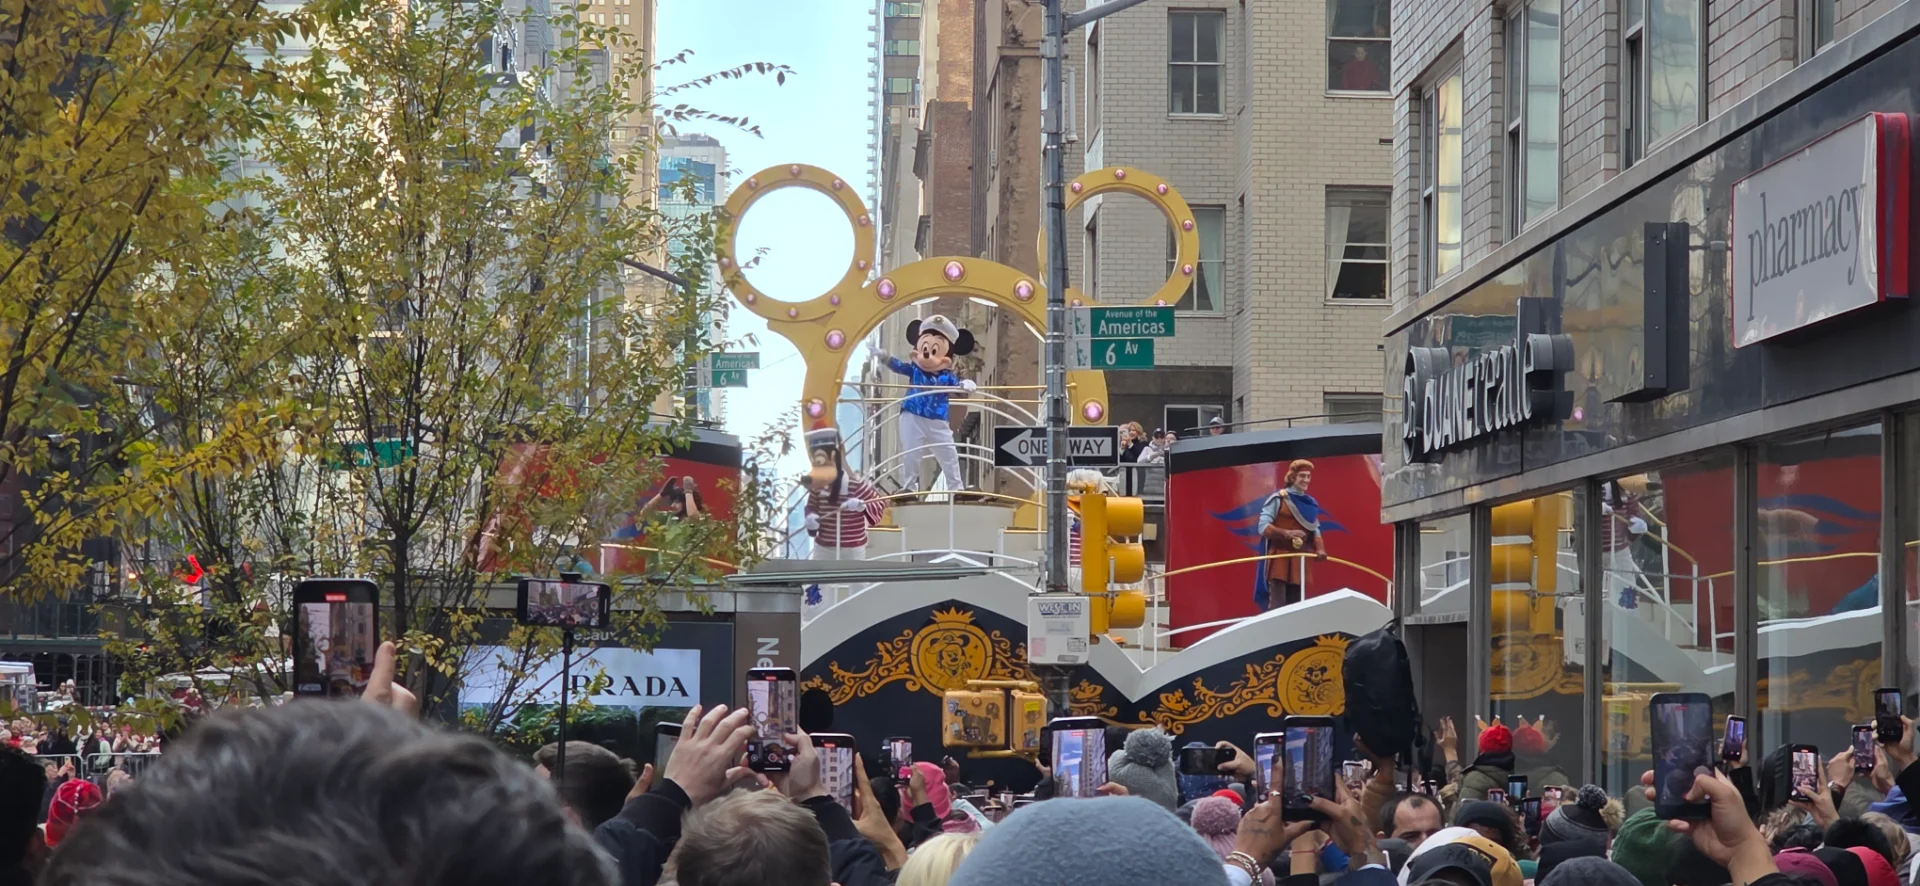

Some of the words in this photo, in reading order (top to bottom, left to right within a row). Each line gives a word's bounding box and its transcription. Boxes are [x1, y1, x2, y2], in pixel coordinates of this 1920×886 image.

[1747, 183, 1866, 322] pharmacy
[1105, 310, 1133, 318] Avenue
[1135, 310, 1143, 318] of
[1145, 310, 1158, 318] the
[1098, 319, 1165, 335] Americas
[1105, 343, 1116, 365] 6
[1125, 341, 1139, 354] Av
[716, 359, 755, 369] Americas
[720, 373, 727, 386] 6
[1018, 439, 1048, 454] ONE
[1069, 439, 1105, 454] WAY
[757, 637, 780, 668] Ne
[571, 674, 689, 698] PRADA
